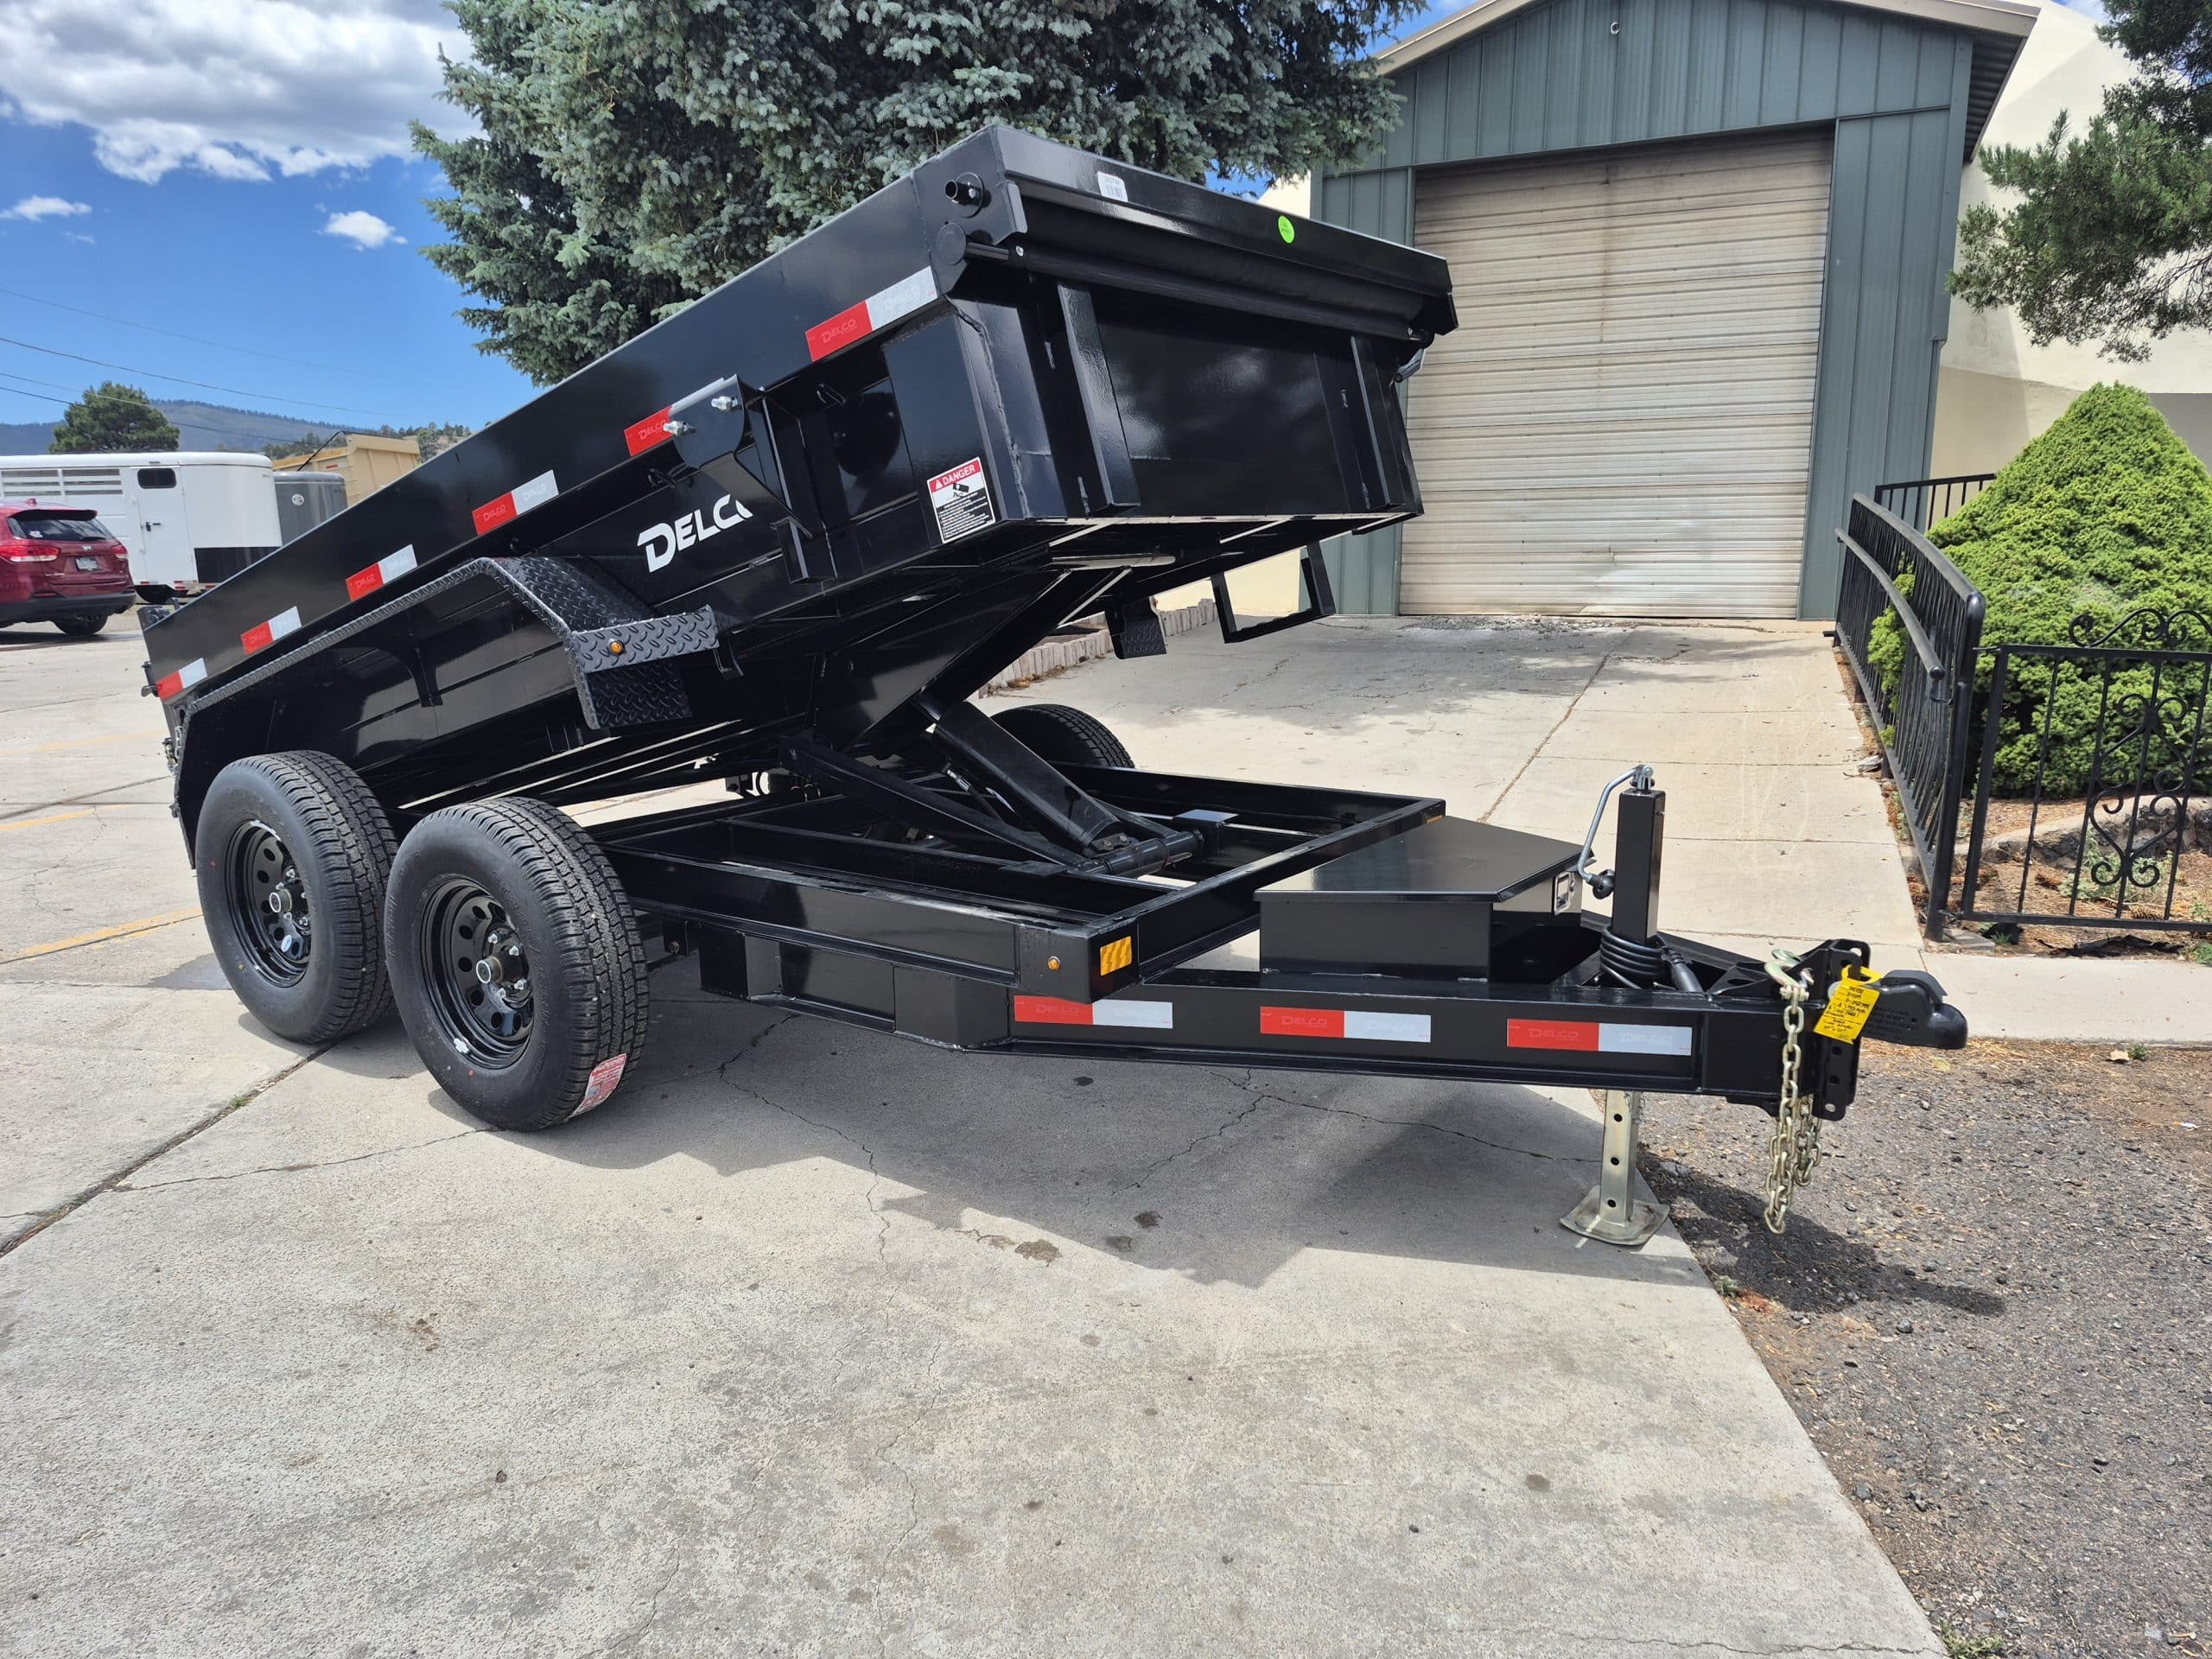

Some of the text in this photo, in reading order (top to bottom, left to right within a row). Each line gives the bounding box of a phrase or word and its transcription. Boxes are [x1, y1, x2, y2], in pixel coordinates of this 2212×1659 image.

[821, 318, 856, 344] DELCO
[943, 464, 976, 486] DANGER
[1036, 1004, 1079, 1014] DELCO
[1281, 1015, 1328, 1026] DELCO
[1527, 1027, 1580, 1038] DELCO
